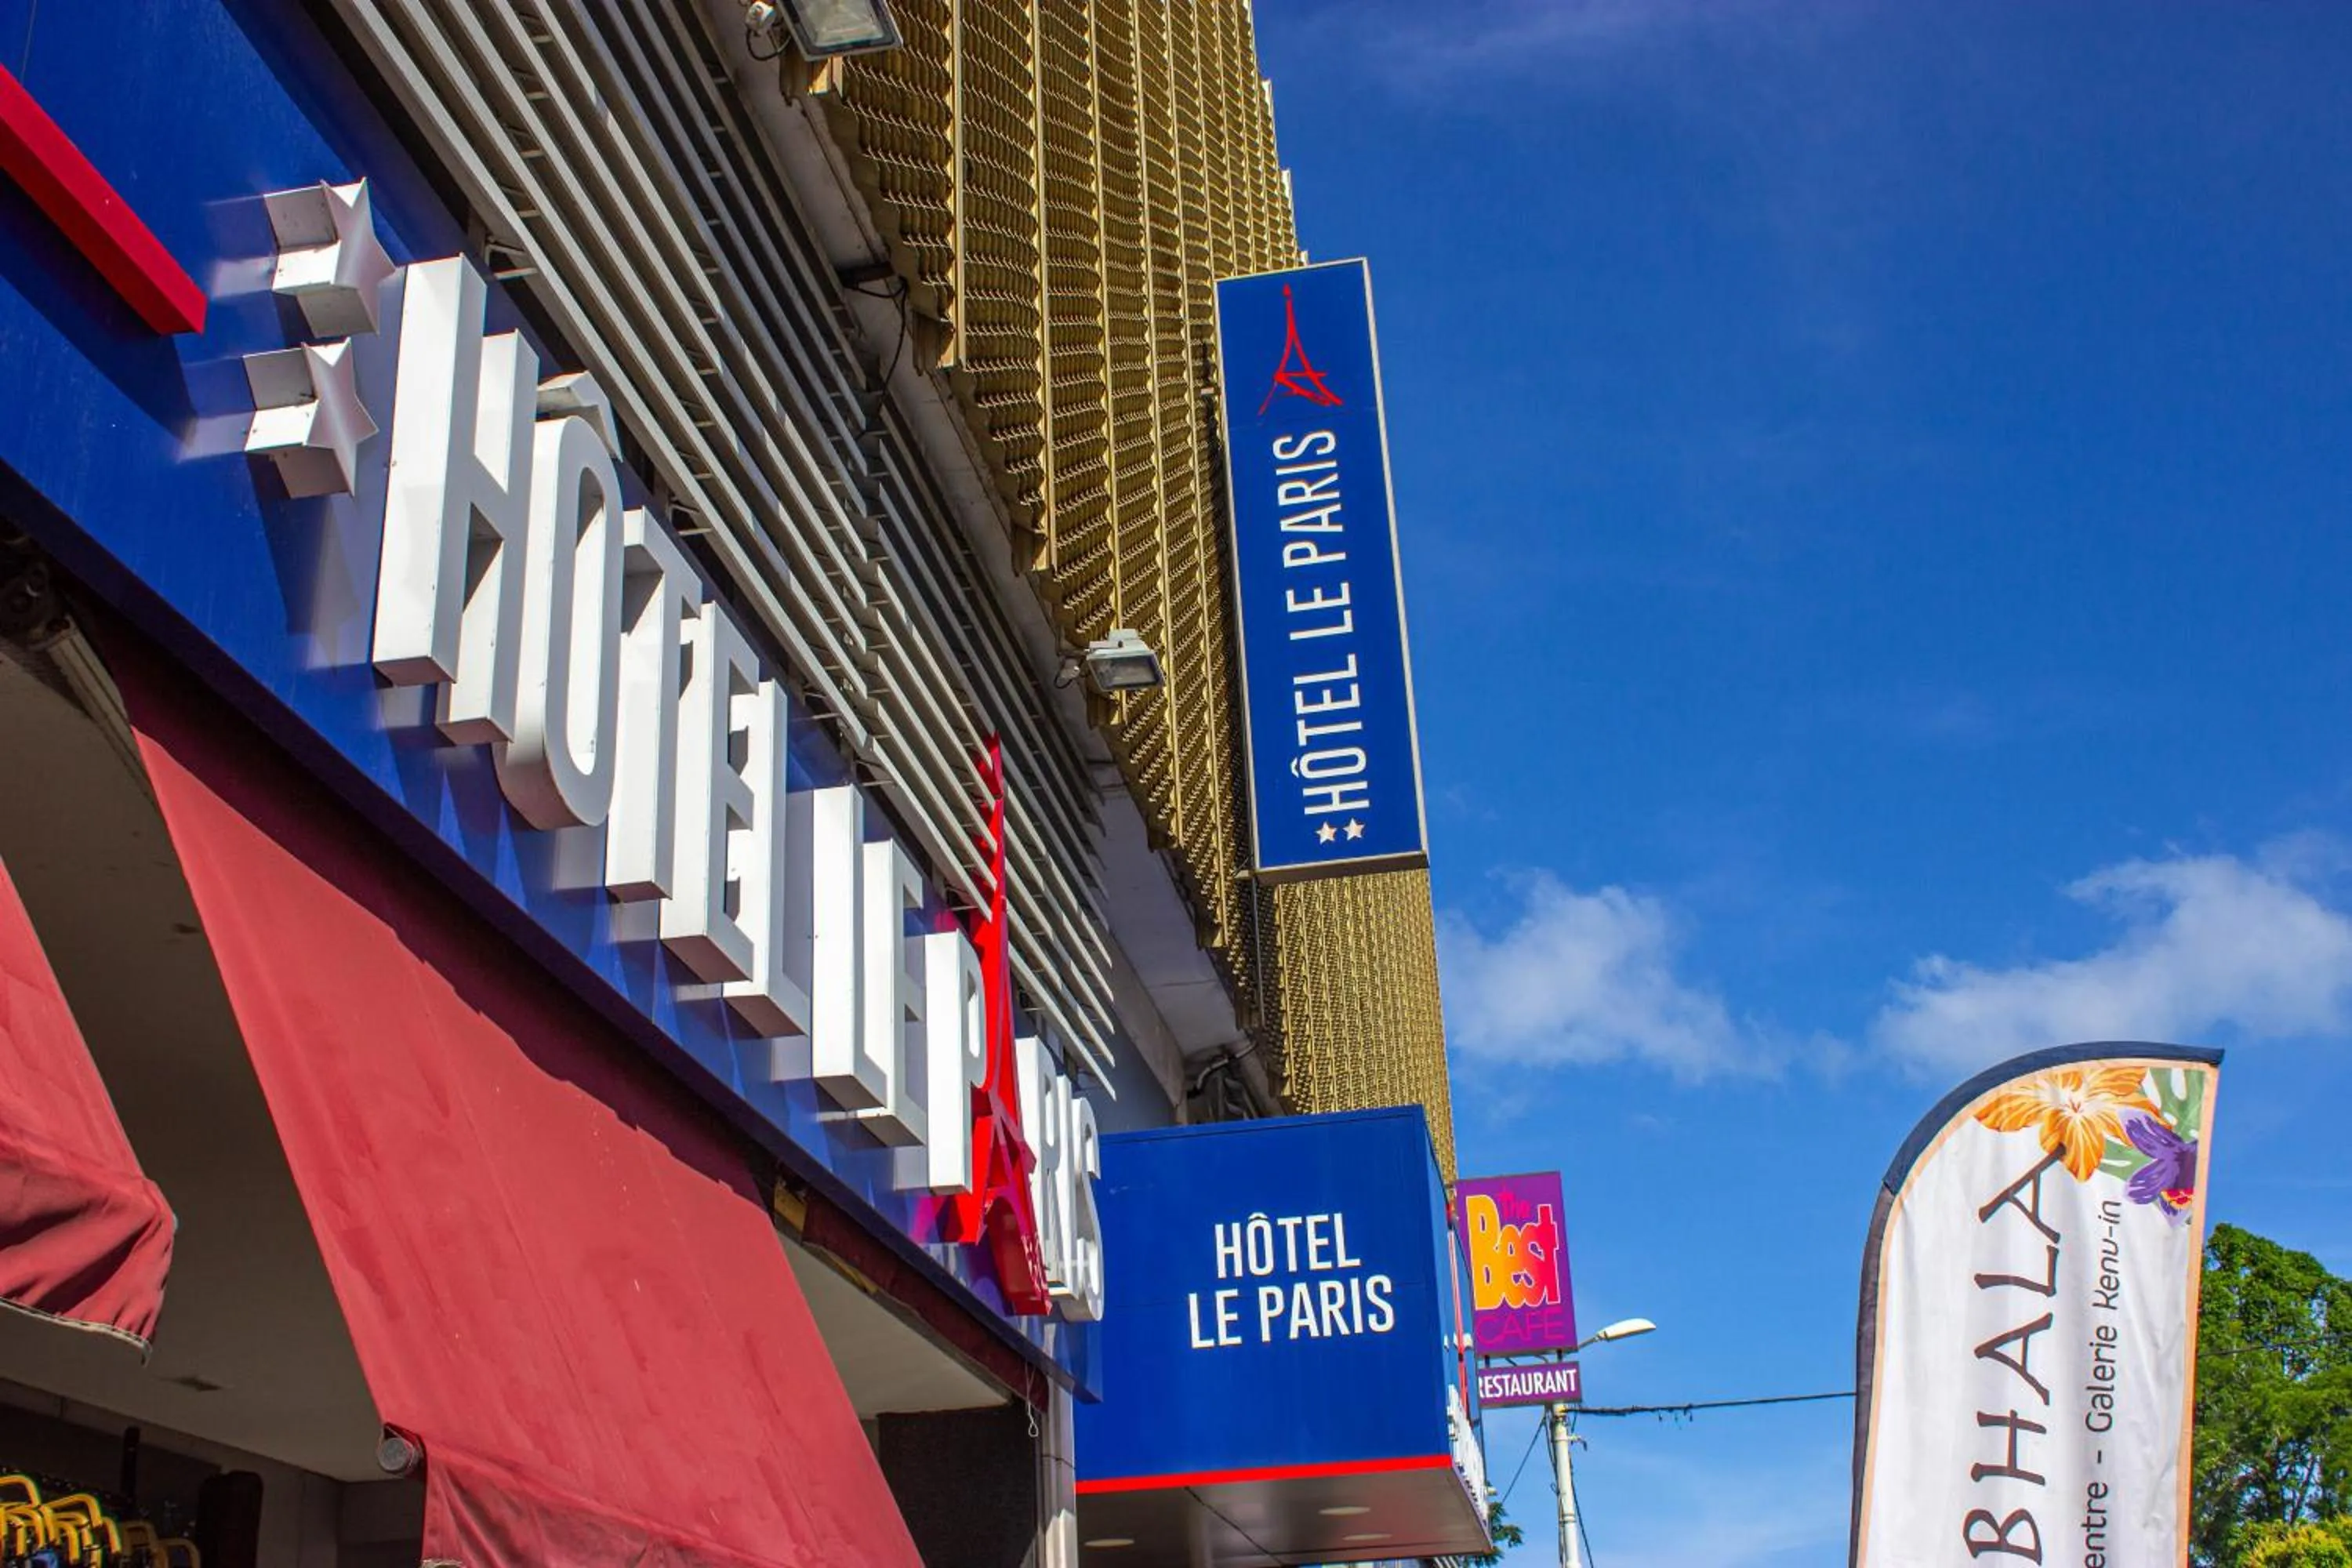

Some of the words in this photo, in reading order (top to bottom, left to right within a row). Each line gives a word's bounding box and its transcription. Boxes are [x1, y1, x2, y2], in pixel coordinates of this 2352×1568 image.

[1272, 429, 1347, 568] PARIS
[1286, 582, 1354, 641] LE
[373, 252, 809, 1036] HÔTEL
[812, 785, 925, 1146] LE
[1290, 653, 1370, 815] HÔTEL
[1214, 1212, 1361, 1279] HÔTEL
[1465, 1194, 1561, 1311] Best
[2092, 1200, 2122, 1310] Kenu-in
[1188, 1288, 1243, 1349] LE
[1258, 1275, 1396, 1343] PARIS
[2085, 1326, 2118, 1433] Galerie
